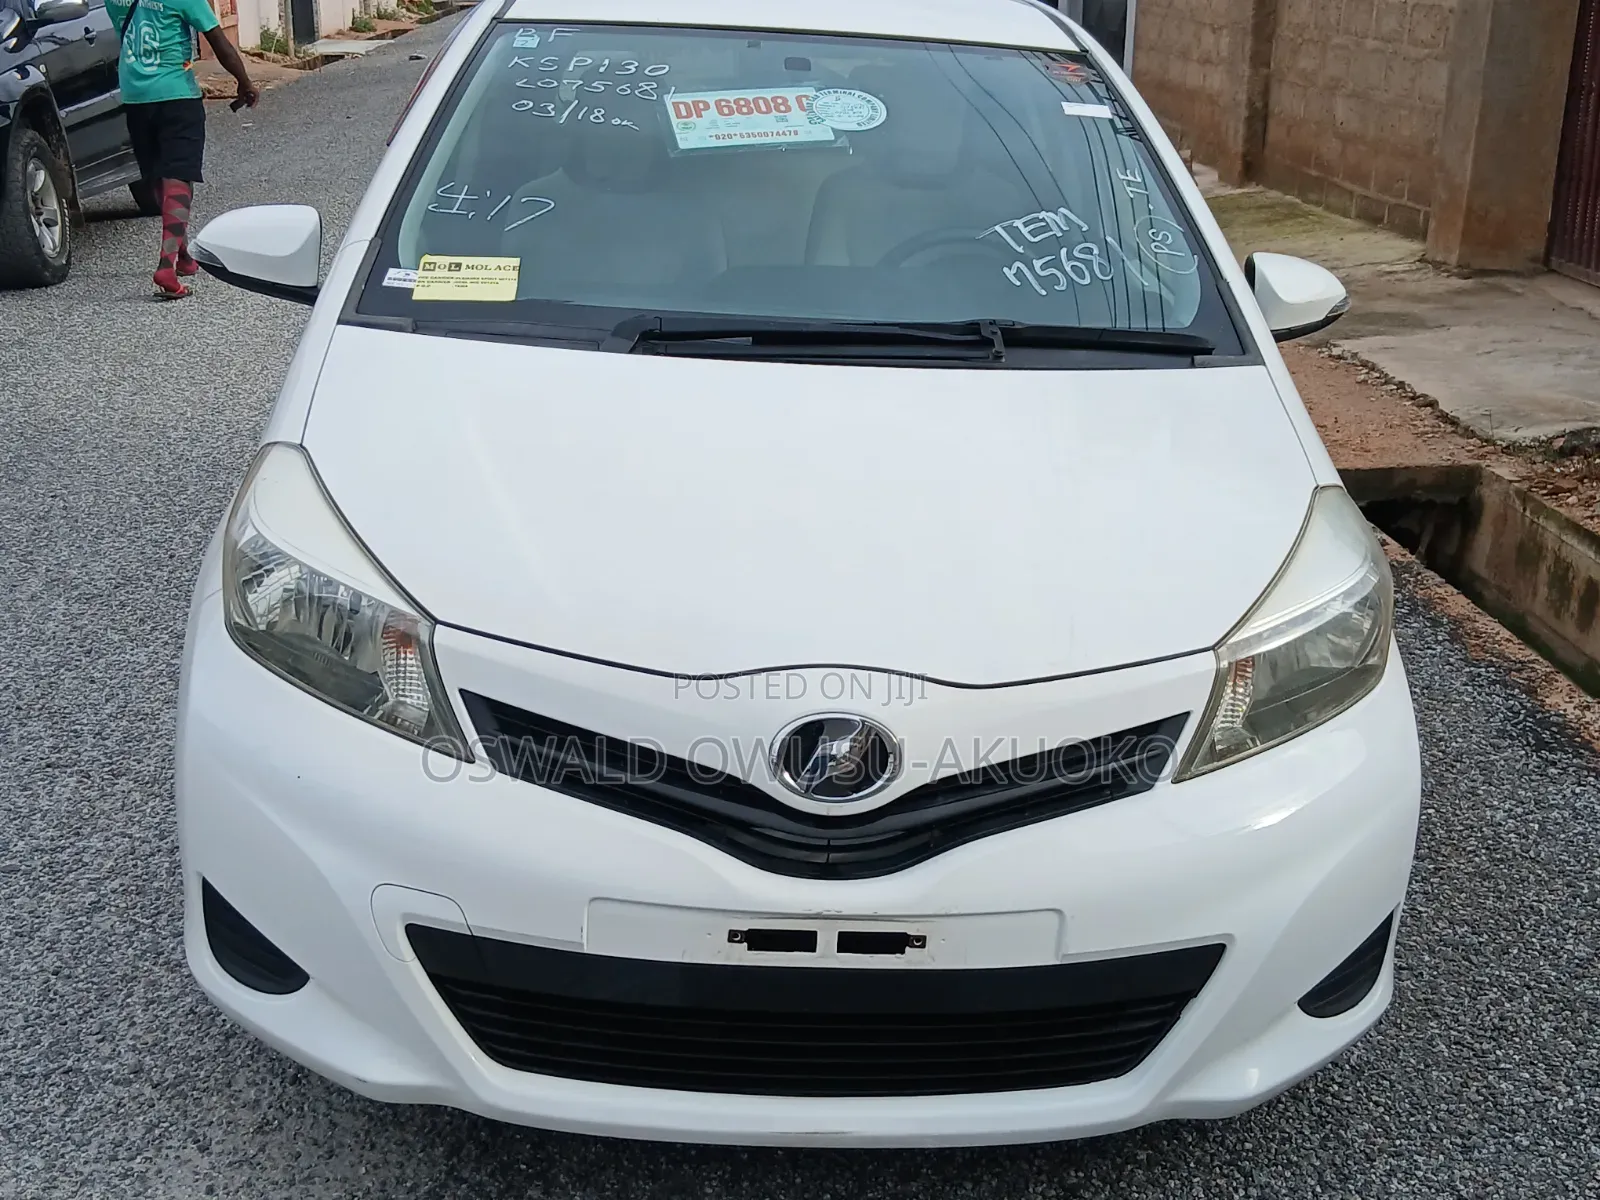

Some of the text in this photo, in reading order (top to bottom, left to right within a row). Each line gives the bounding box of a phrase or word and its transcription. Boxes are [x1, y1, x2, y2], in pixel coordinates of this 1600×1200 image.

[508, 56, 670, 77] KSP130
[671, 98, 710, 119] DP
[714, 95, 792, 117] 6808
[975, 206, 1089, 253] TEM
